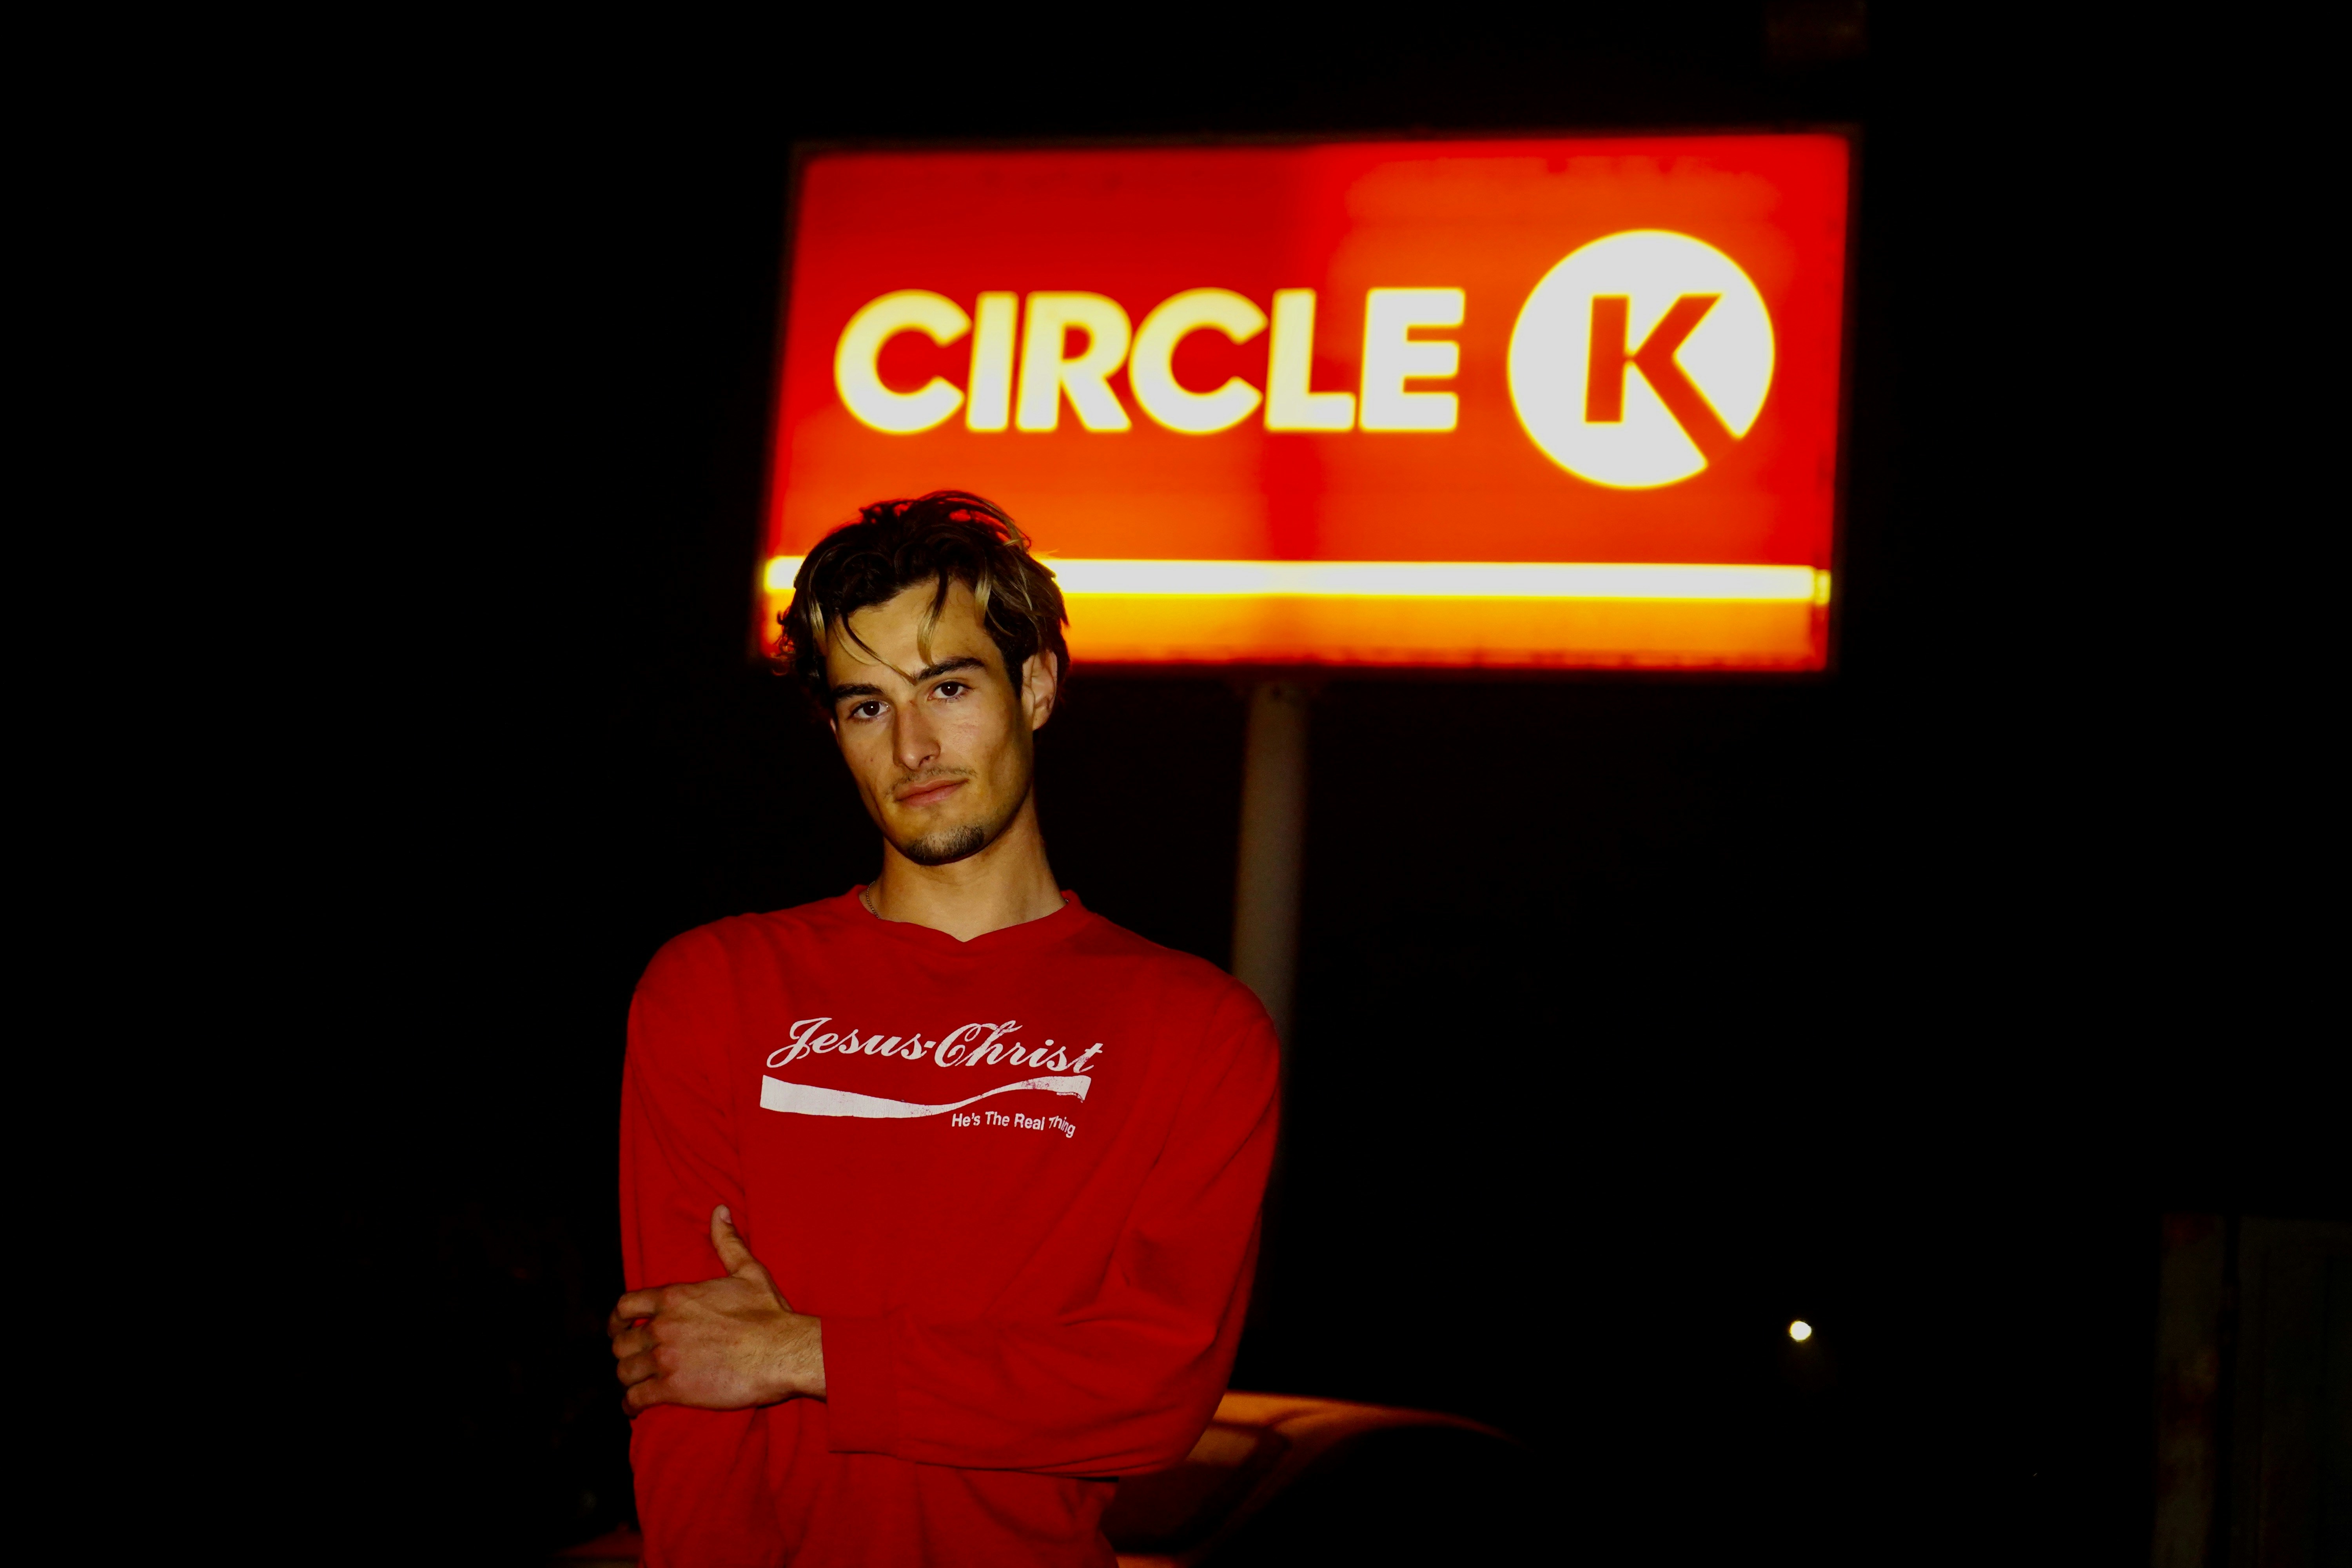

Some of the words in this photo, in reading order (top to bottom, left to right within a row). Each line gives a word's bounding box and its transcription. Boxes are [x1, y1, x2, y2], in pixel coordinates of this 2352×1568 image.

[835, 287, 1466, 436] CIRCLE
[1584, 293, 1741, 466] K
[951, 1112, 981, 1127] He's
[985, 1111, 1010, 1127] The
[1014, 1113, 1045, 1131] Real
[1048, 1115, 1076, 1138] Thing
